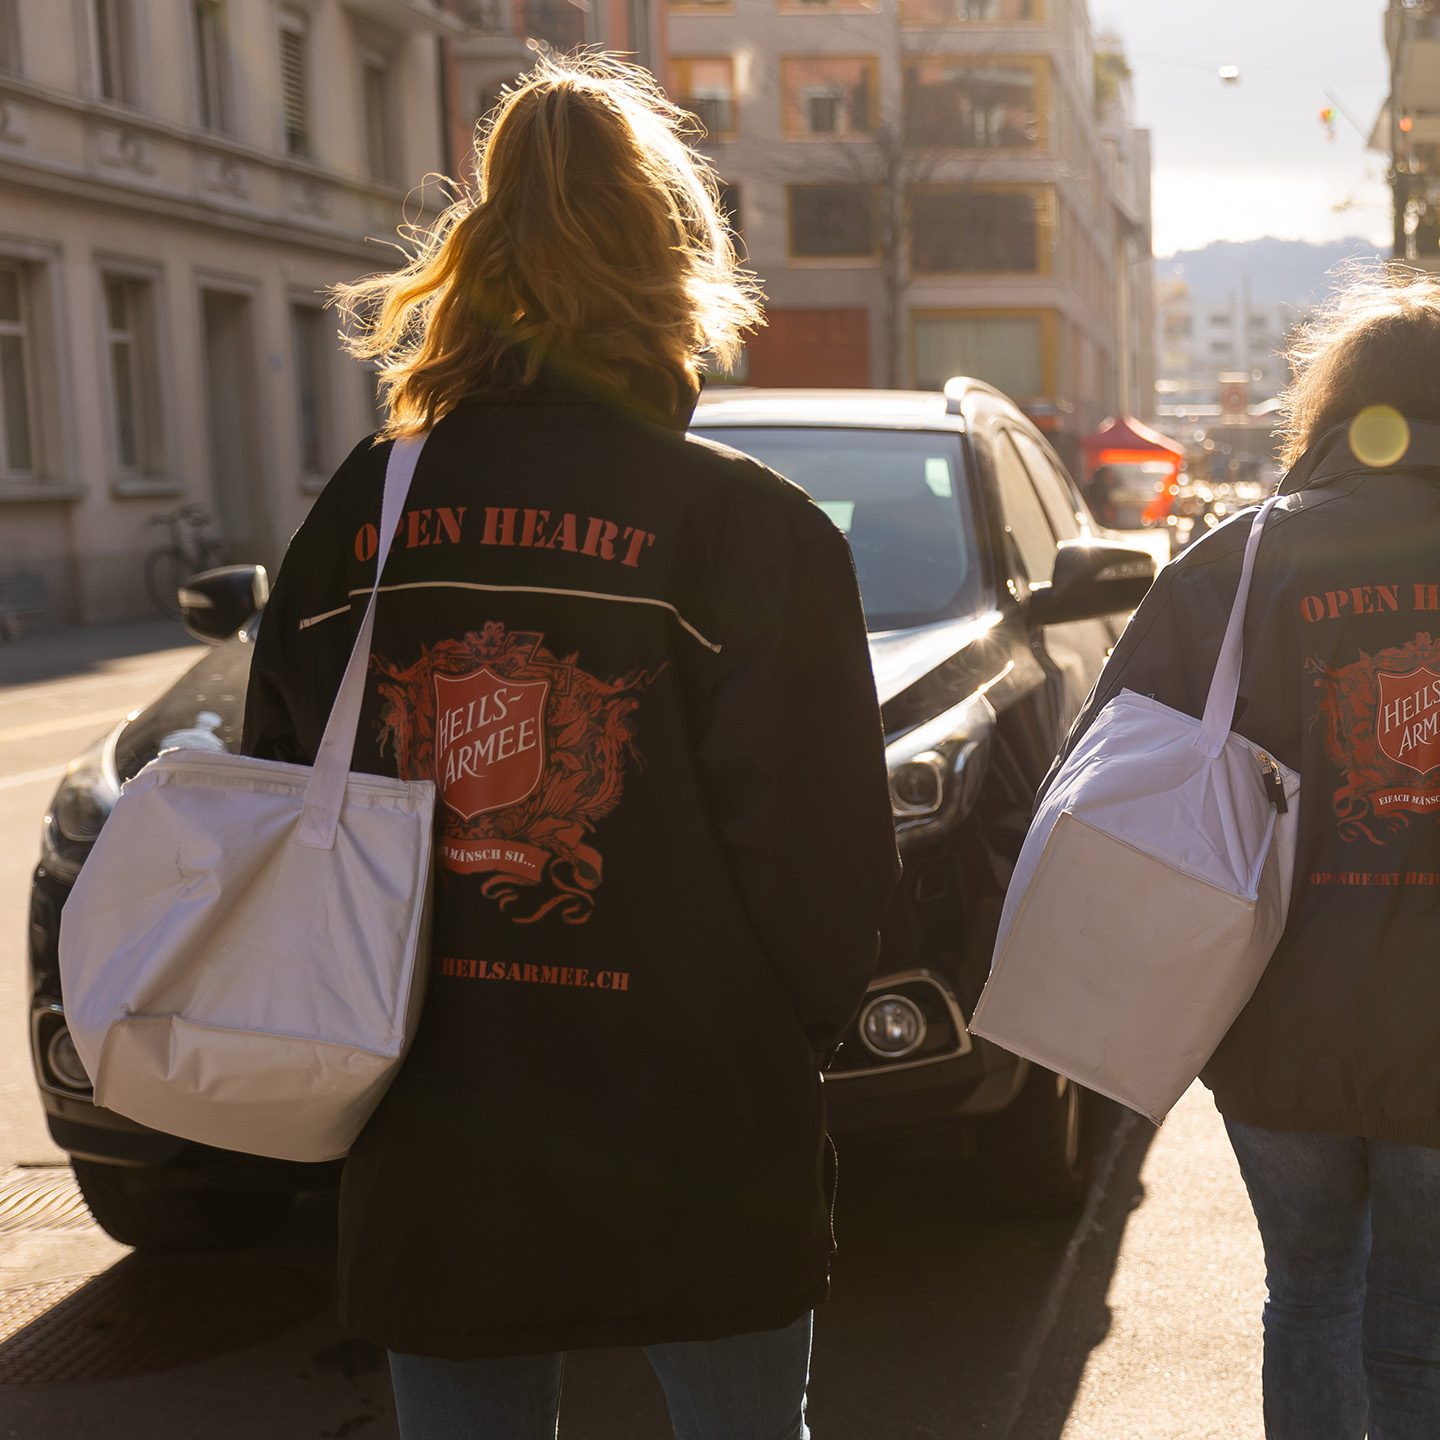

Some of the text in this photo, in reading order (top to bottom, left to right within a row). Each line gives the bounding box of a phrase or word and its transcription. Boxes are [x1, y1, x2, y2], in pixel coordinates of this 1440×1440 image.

[354, 507, 656, 568] OEN HEART
[1301, 584, 1399, 623] OPEN
[439, 687, 524, 758] HEILS-
[444, 718, 537, 792] ARMEE
[1379, 794, 1409, 806] EIFACH
[443, 957, 630, 991] HEILSARMEE.CH
